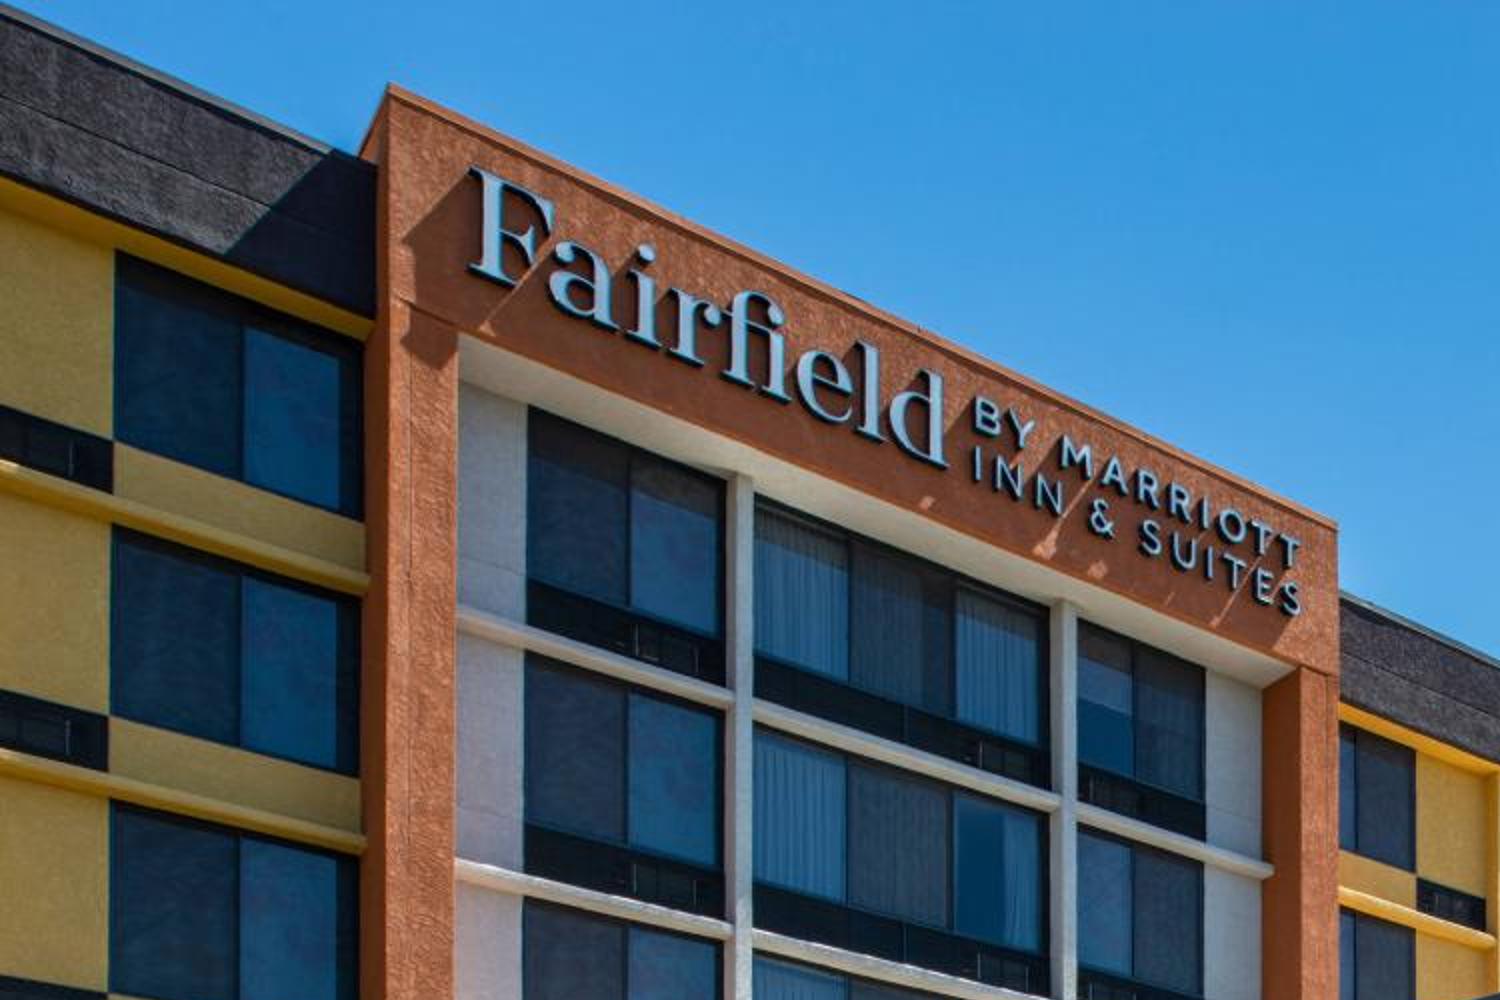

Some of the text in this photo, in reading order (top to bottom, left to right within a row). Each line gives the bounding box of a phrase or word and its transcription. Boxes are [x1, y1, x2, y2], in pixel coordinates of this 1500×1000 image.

[468, 166, 948, 470] Fairfield
[973, 445, 1303, 618] INN & SUITES
[974, 396, 1301, 569] BY MARRIOTT
